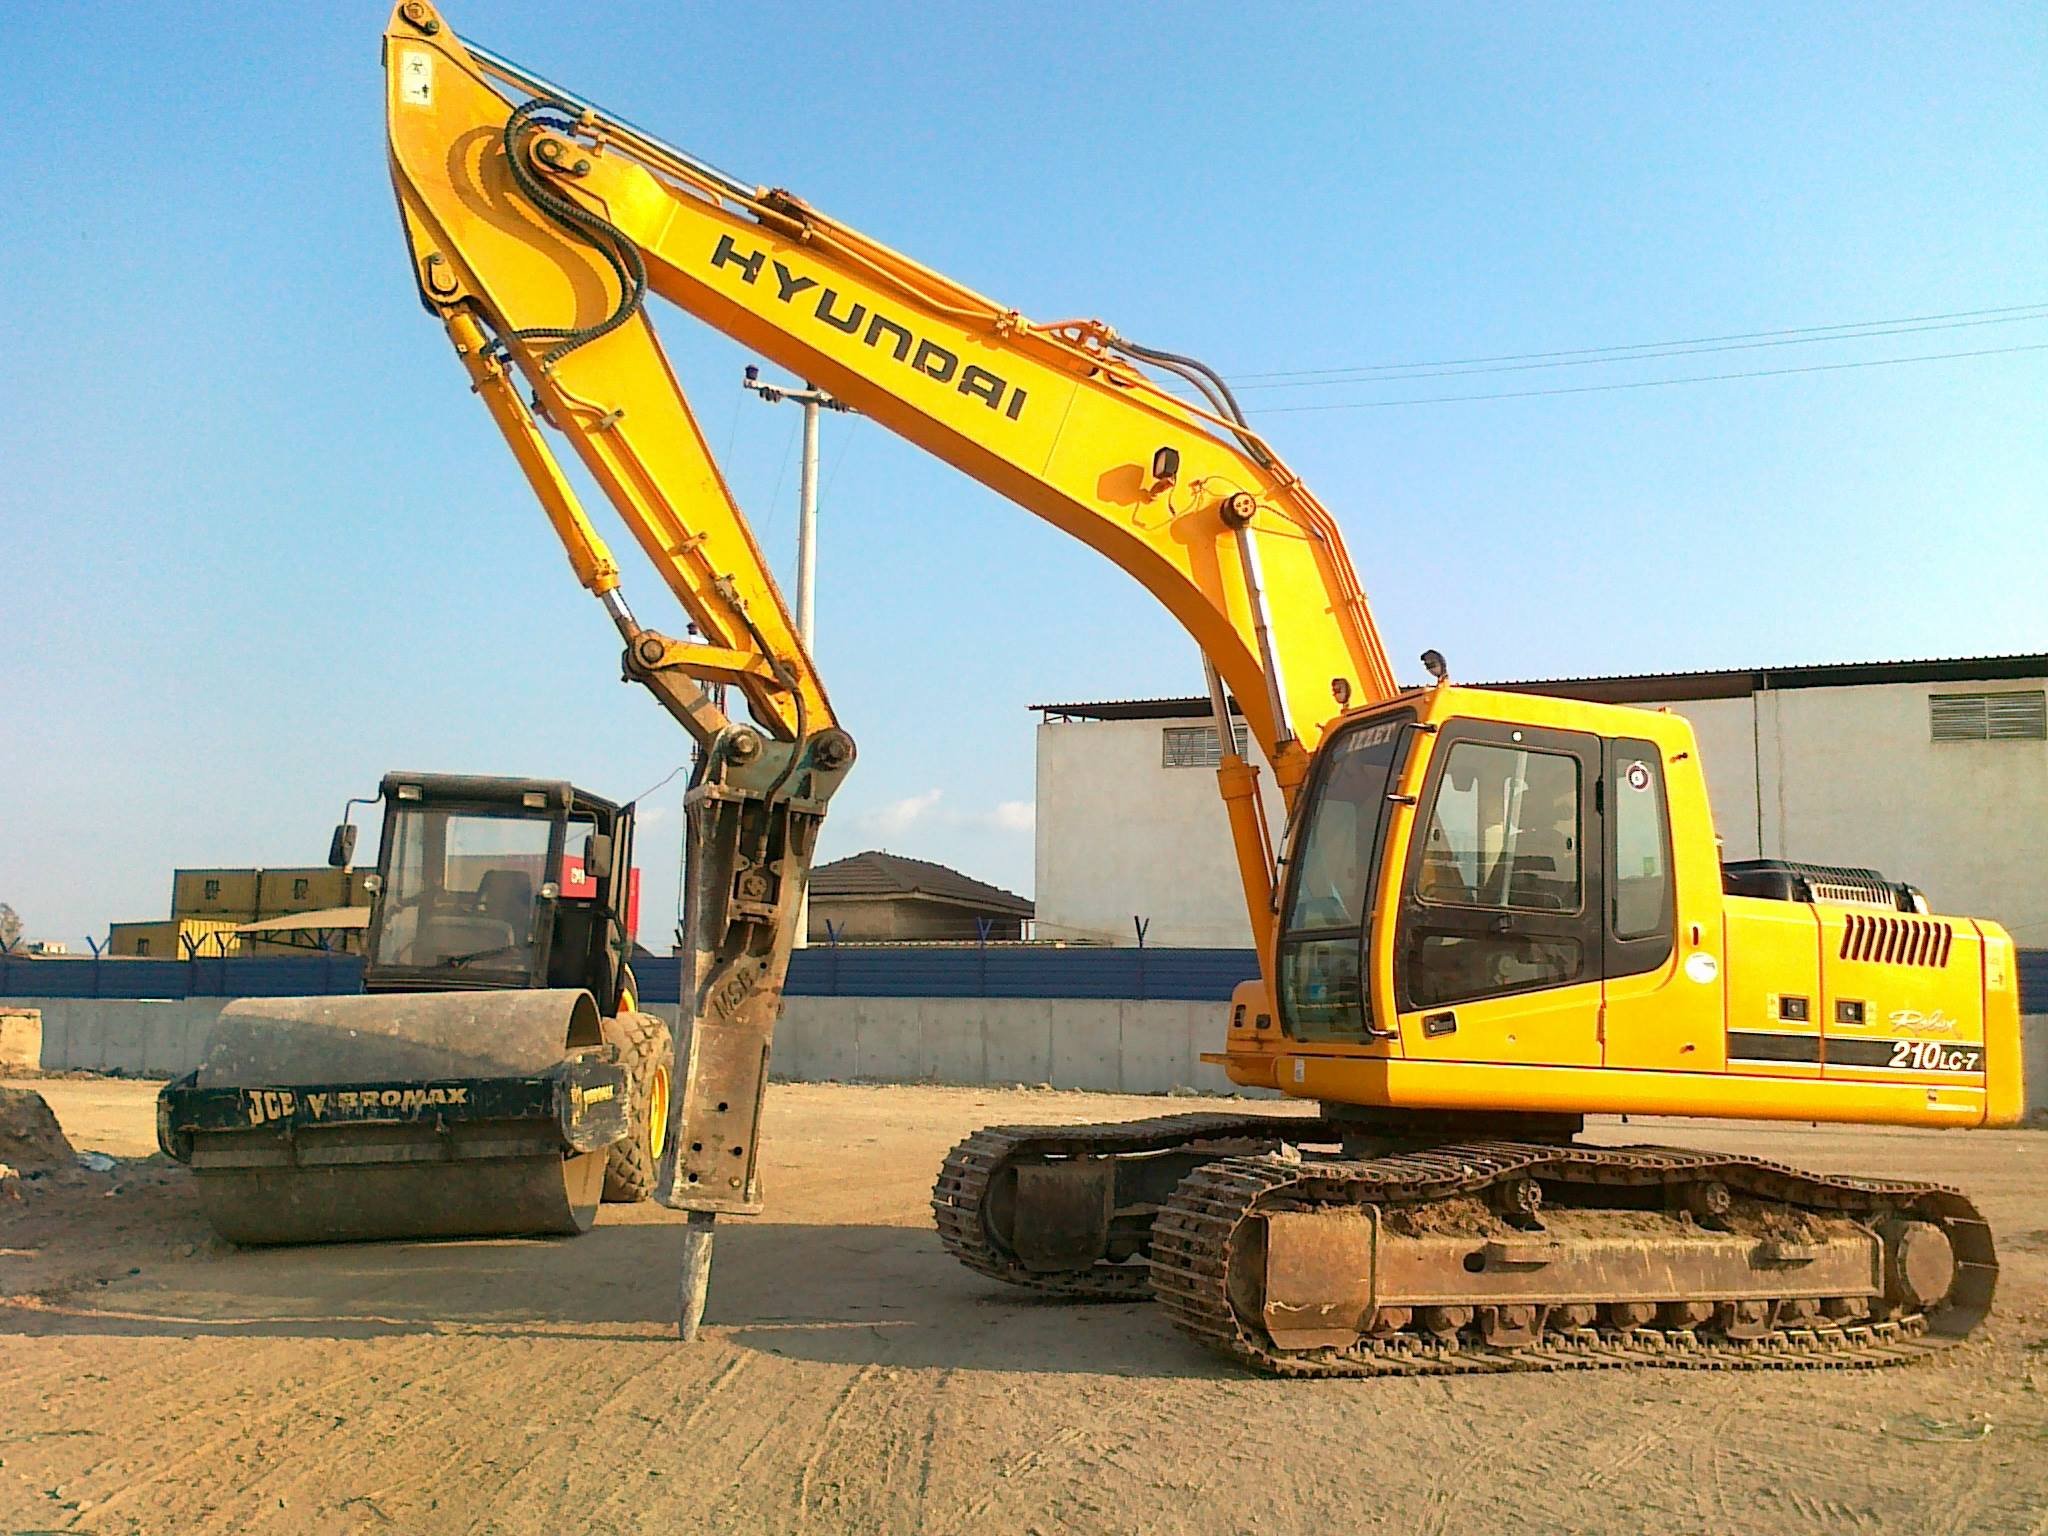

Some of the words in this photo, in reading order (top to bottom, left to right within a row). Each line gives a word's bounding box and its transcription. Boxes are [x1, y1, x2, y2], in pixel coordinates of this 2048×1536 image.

[711, 234, 1027, 420] HYUNDAI
[1888, 1040, 1979, 1070] 210LC-7
[307, 1088, 468, 1120] VBROMAX
